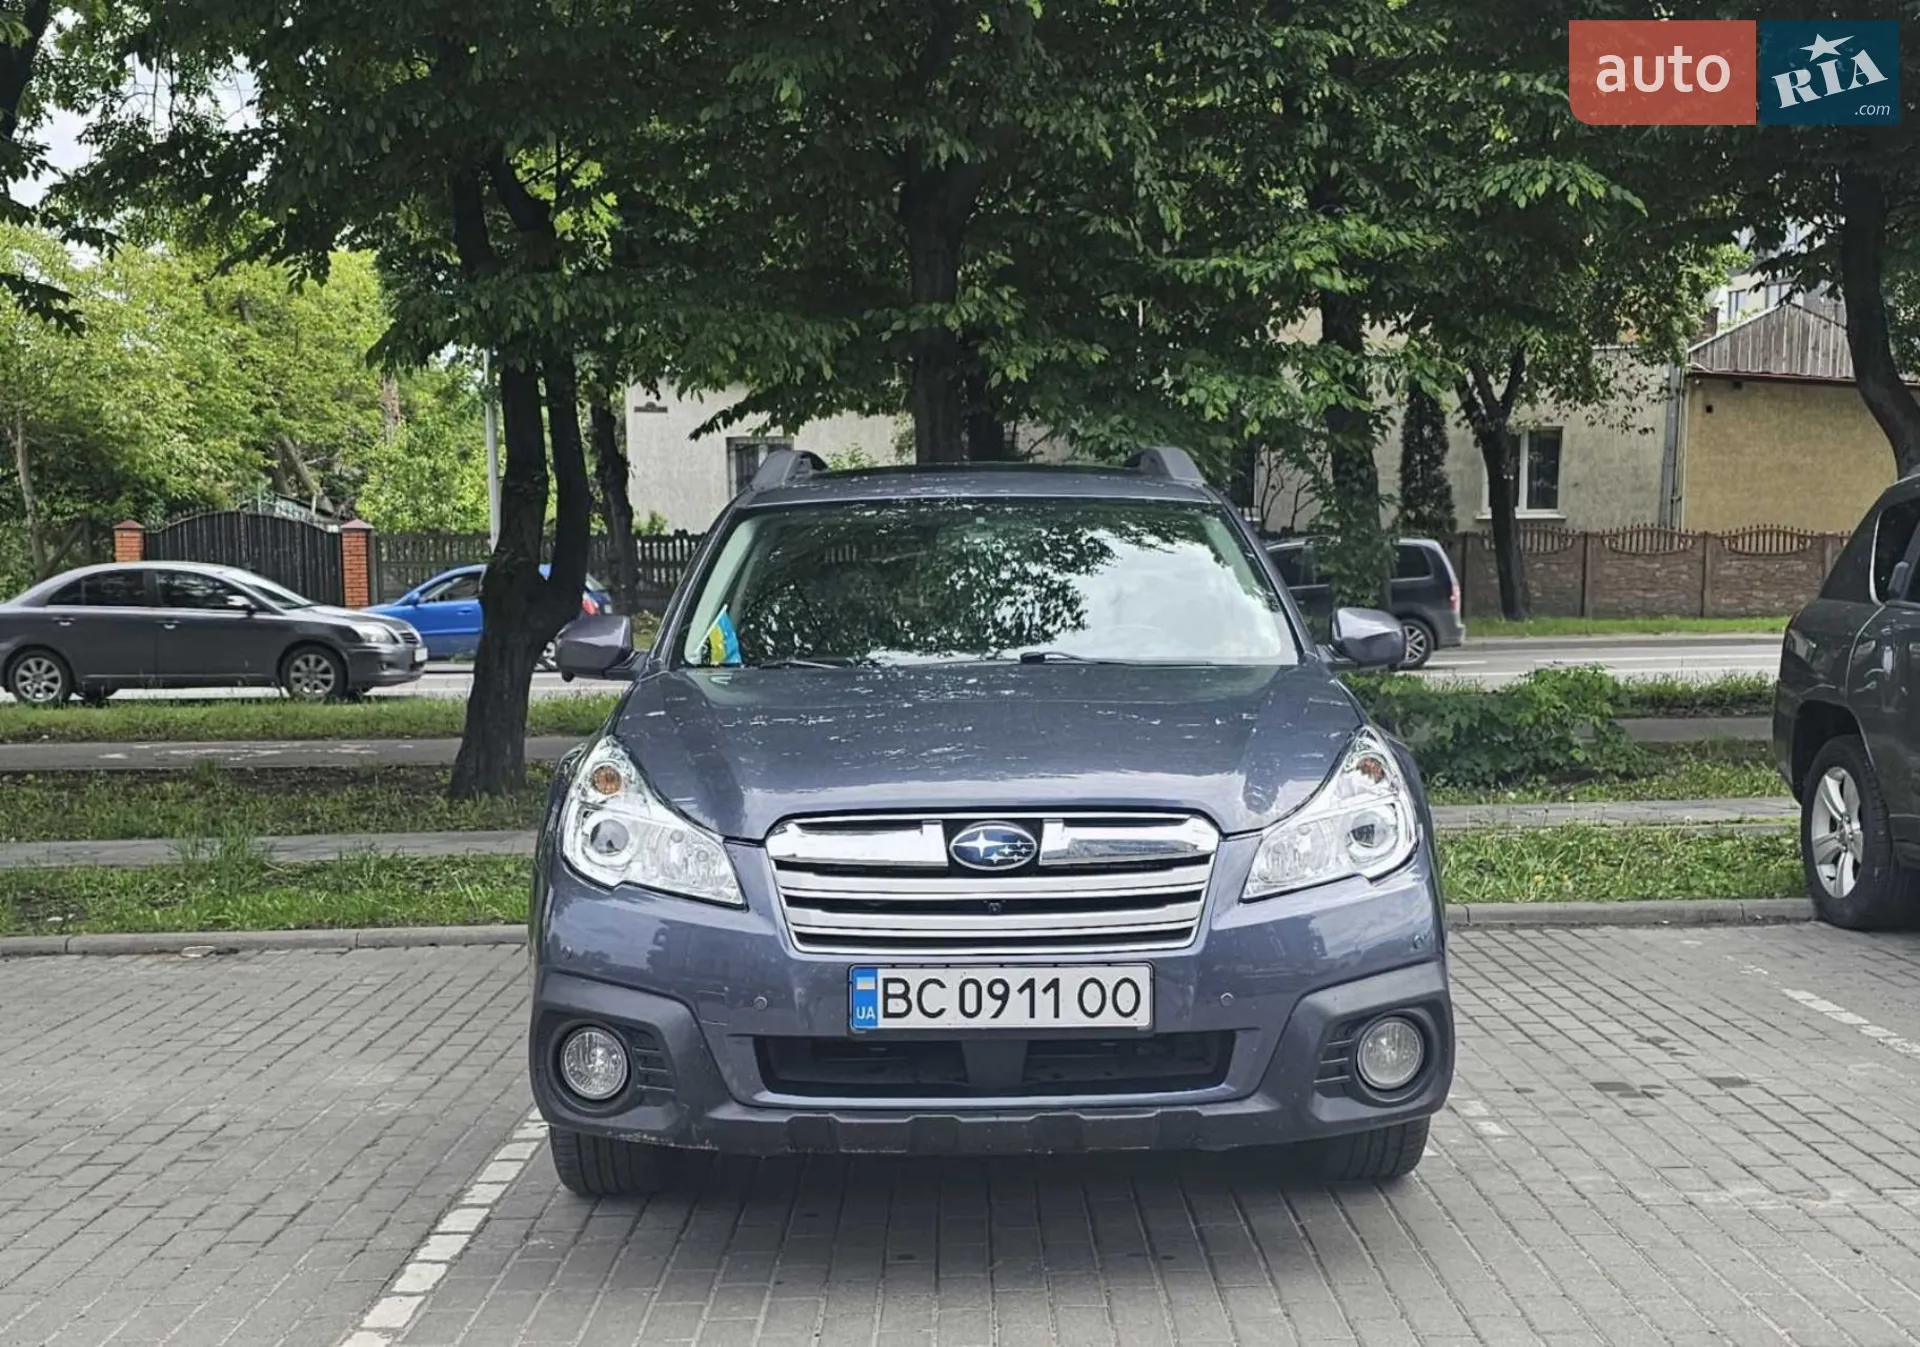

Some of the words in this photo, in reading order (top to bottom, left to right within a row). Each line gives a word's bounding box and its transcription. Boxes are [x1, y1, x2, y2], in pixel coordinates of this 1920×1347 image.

[882, 977, 947, 1019] BC
[958, 977, 1060, 1019] 0911
[856, 1006, 875, 1019] UA
